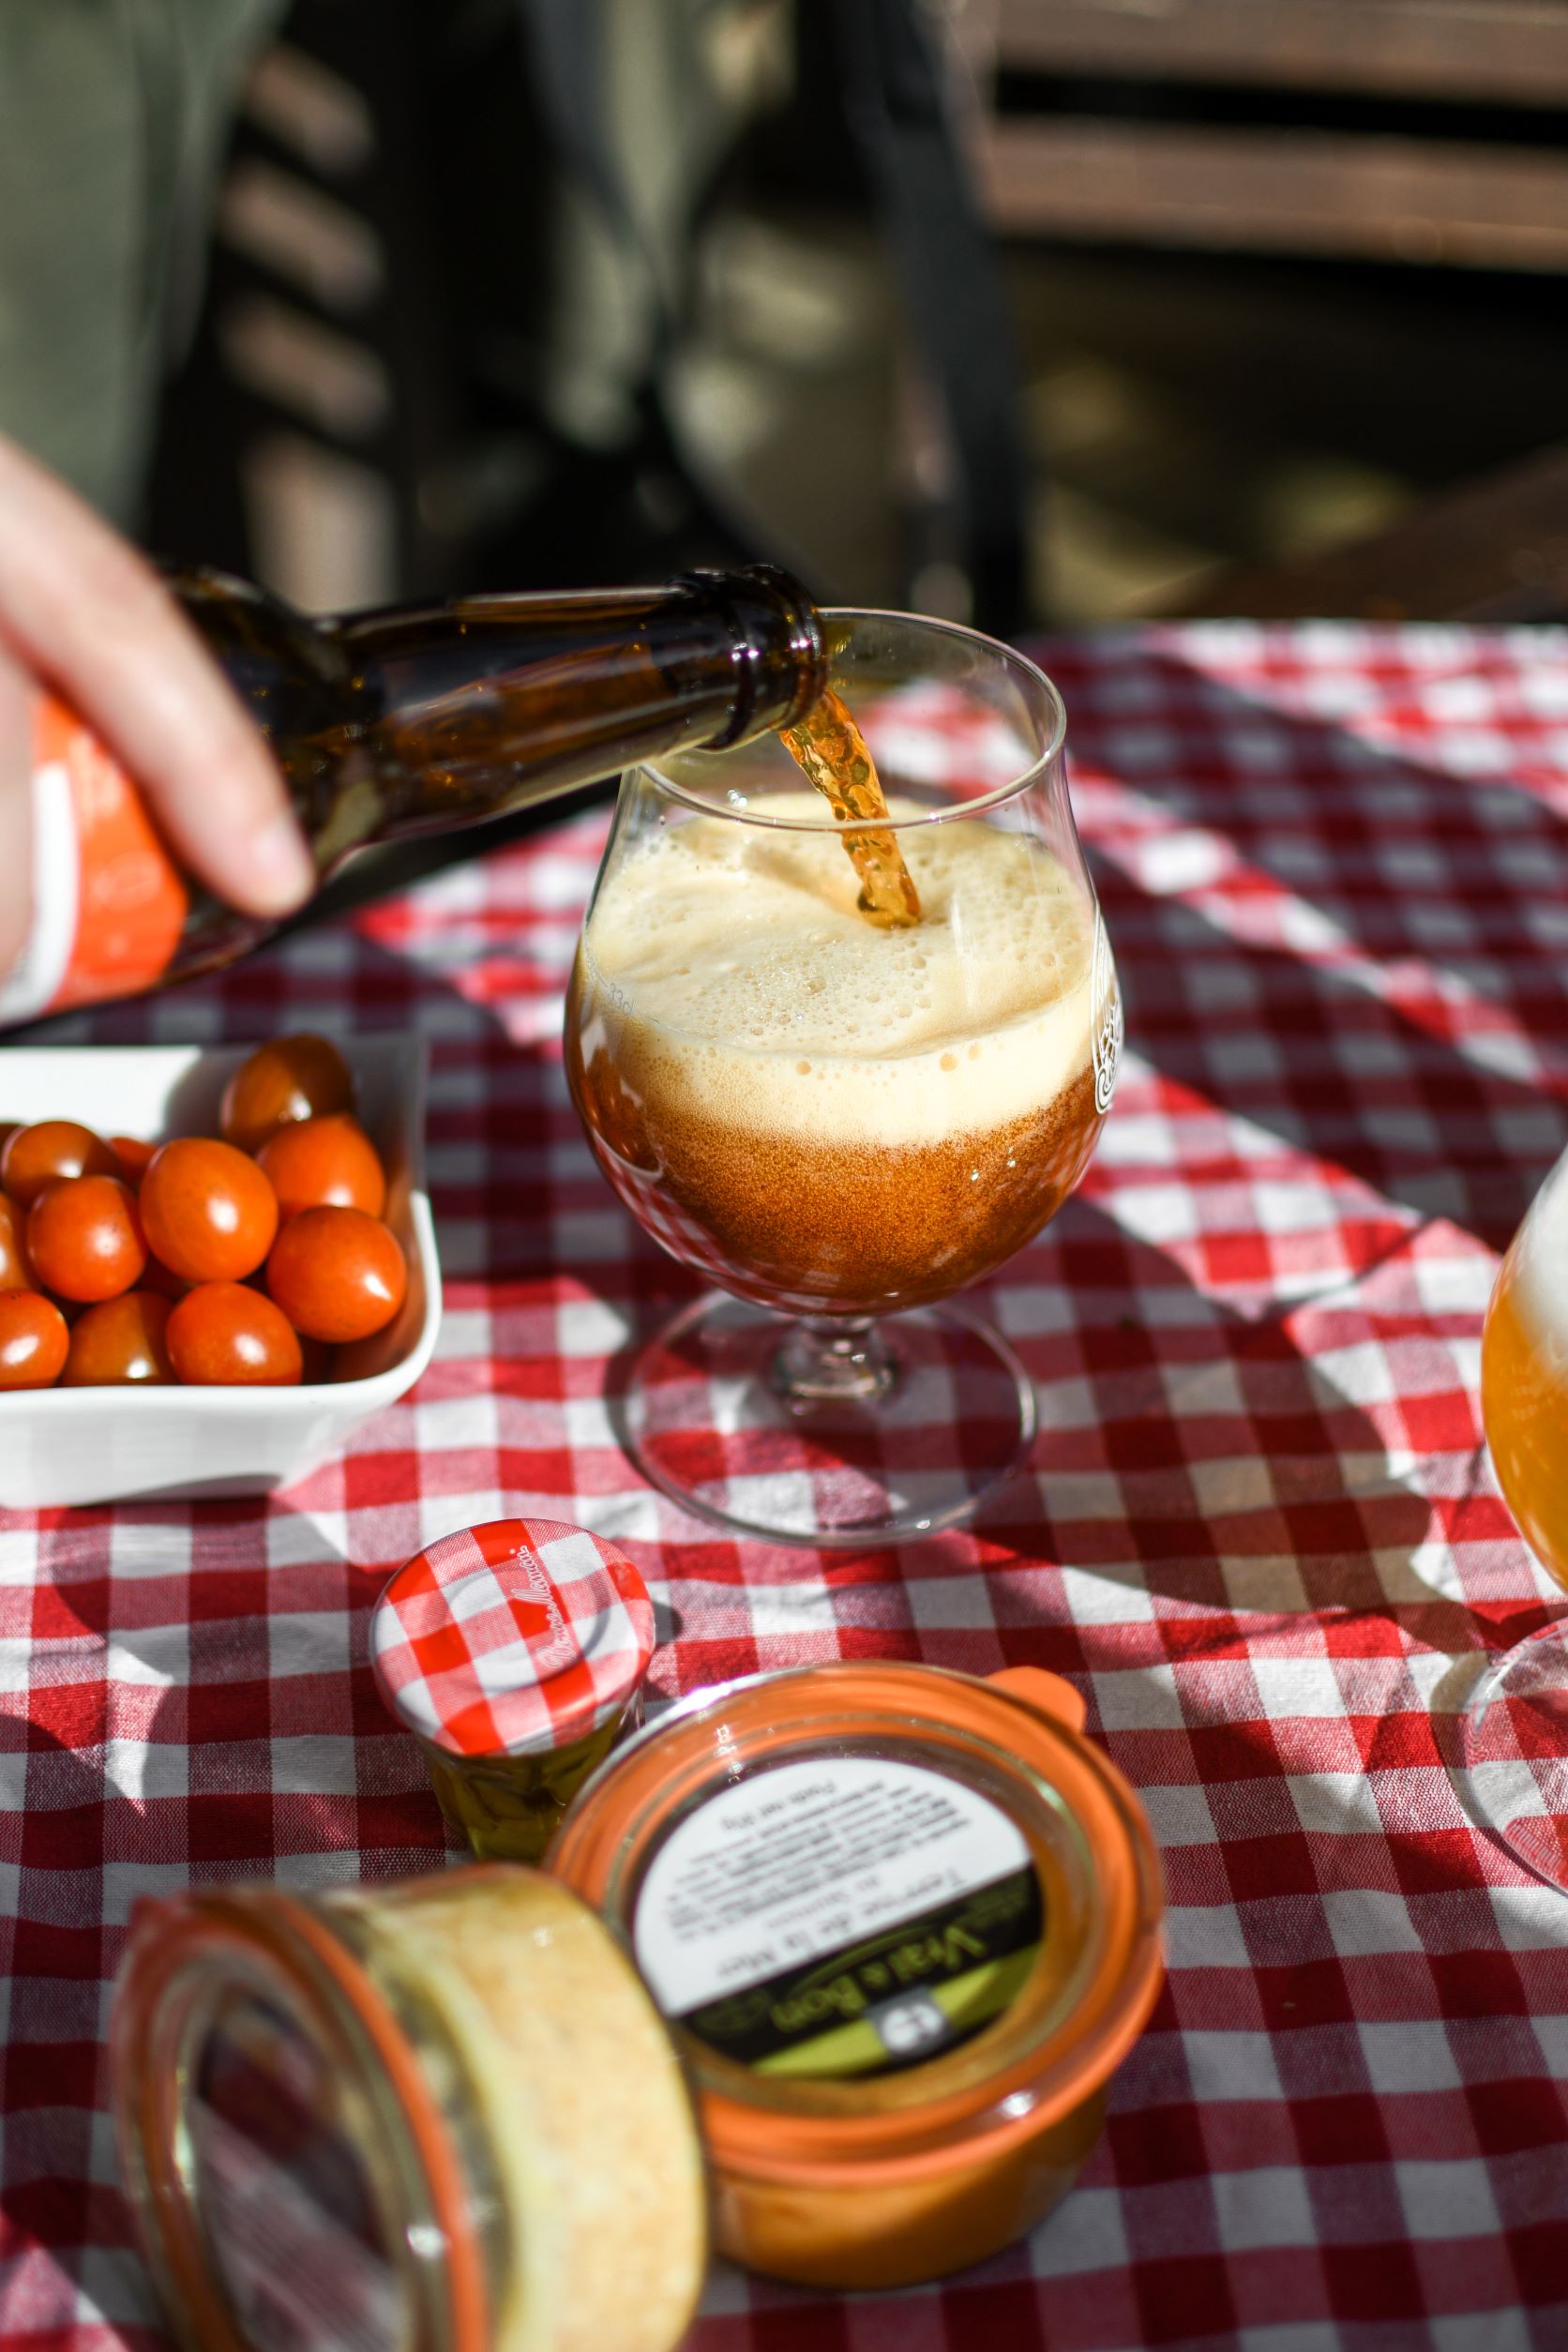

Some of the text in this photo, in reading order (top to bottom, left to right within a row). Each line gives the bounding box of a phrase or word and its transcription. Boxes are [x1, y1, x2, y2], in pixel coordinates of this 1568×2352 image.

[510, 1545, 577, 1669] Bonne Maman
[819, 1911, 851, 1936] de
[716, 1944, 776, 1977] Mer
[890, 1924, 985, 1983] Vrai
[770, 1973, 867, 2033] Bon
